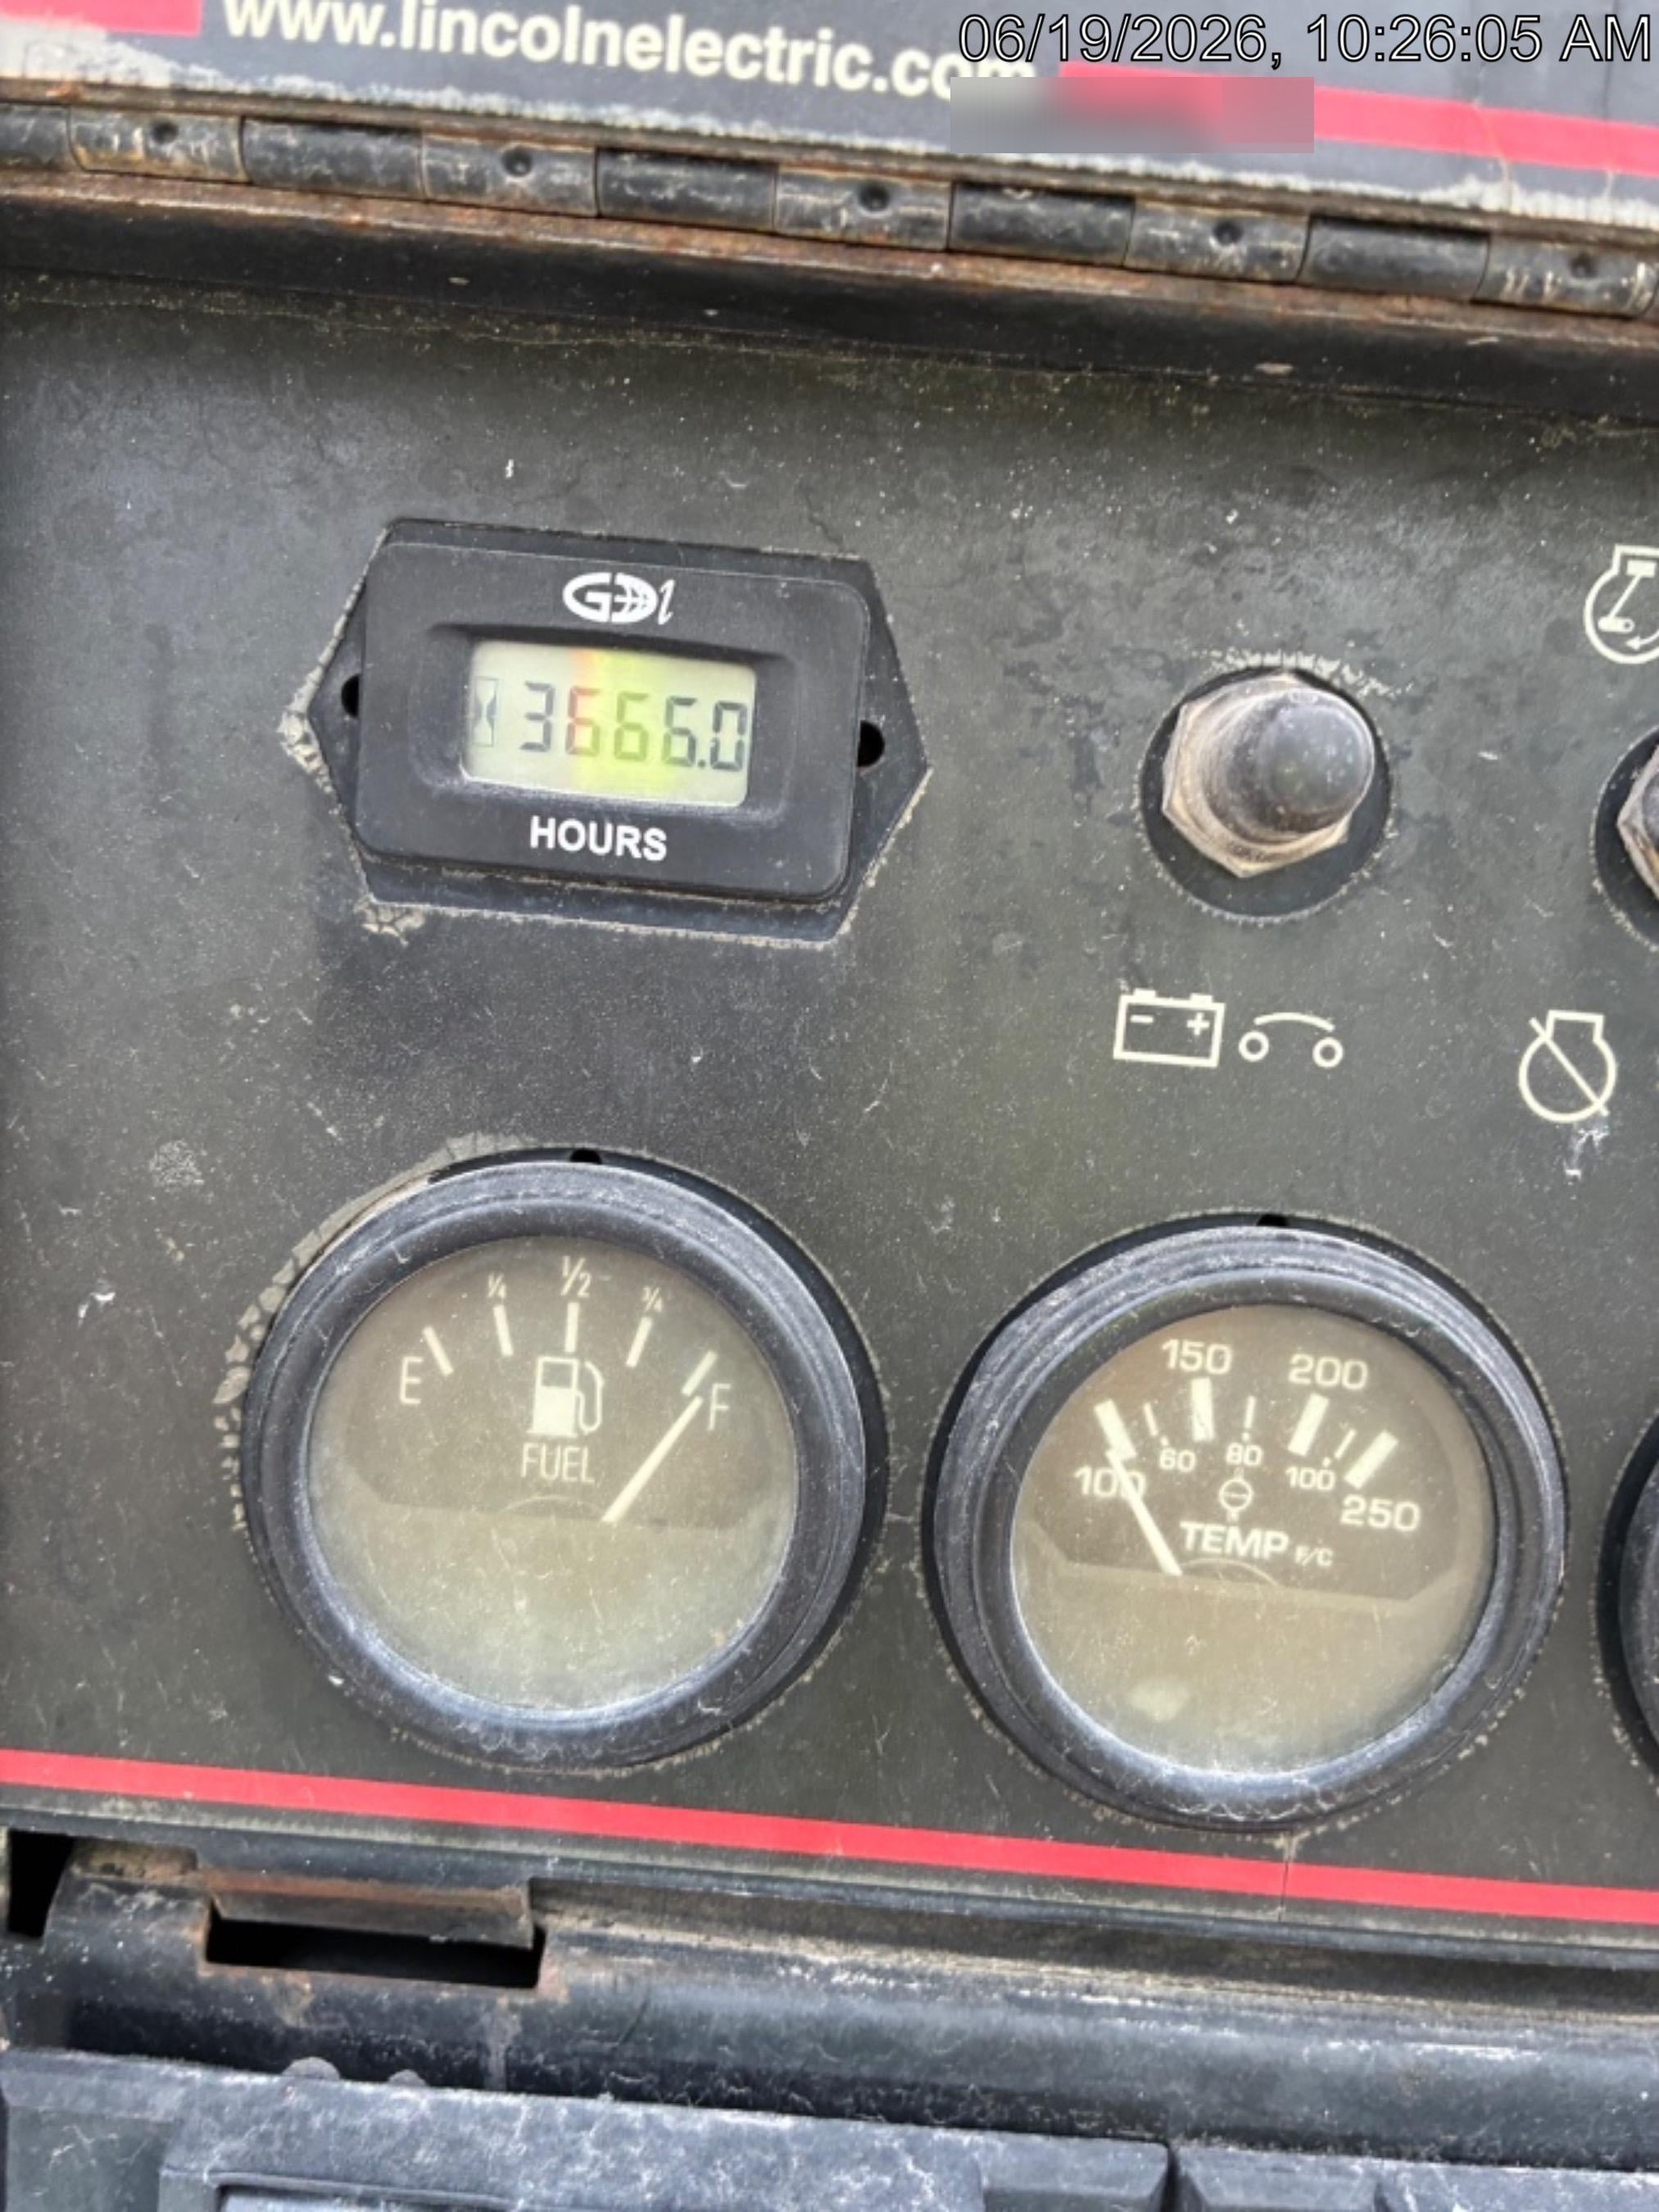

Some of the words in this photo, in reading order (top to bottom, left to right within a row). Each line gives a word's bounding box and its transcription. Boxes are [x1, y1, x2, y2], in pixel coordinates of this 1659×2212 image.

[519, 681, 748, 773] 3666.0
[529, 815, 668, 862] HOURS
[1162, 1338, 1234, 1376] 150
[1288, 1353, 1369, 1390] 200
[399, 1356, 424, 1405] E
[708, 1383, 732, 1431] F
[520, 1442, 596, 1484] FUEL
[1158, 1448, 1197, 1473] 60
[1226, 1443, 1264, 1467] 80
[1073, 1465, 1147, 1500] 100
[1285, 1466, 1336, 1493] 100
[1339, 1494, 1421, 1533] 250
[1180, 1521, 1290, 1559] TEMP
